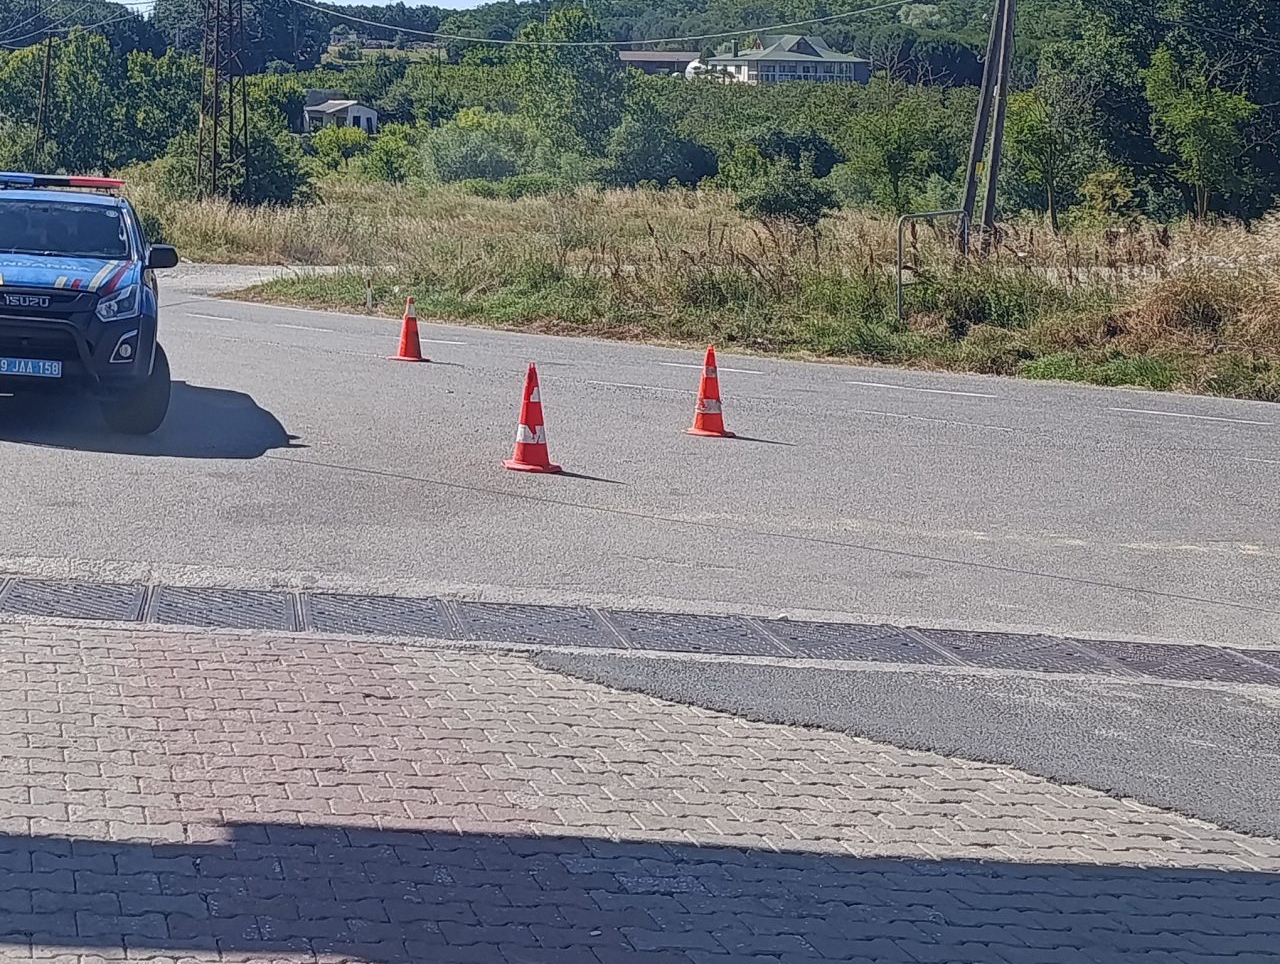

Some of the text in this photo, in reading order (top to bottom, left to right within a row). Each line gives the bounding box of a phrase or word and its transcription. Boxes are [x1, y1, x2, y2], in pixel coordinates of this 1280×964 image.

[4, 294, 50, 307] ISUZU
[12, 360, 34, 373] JAA
[38, 361, 59, 375] 158
